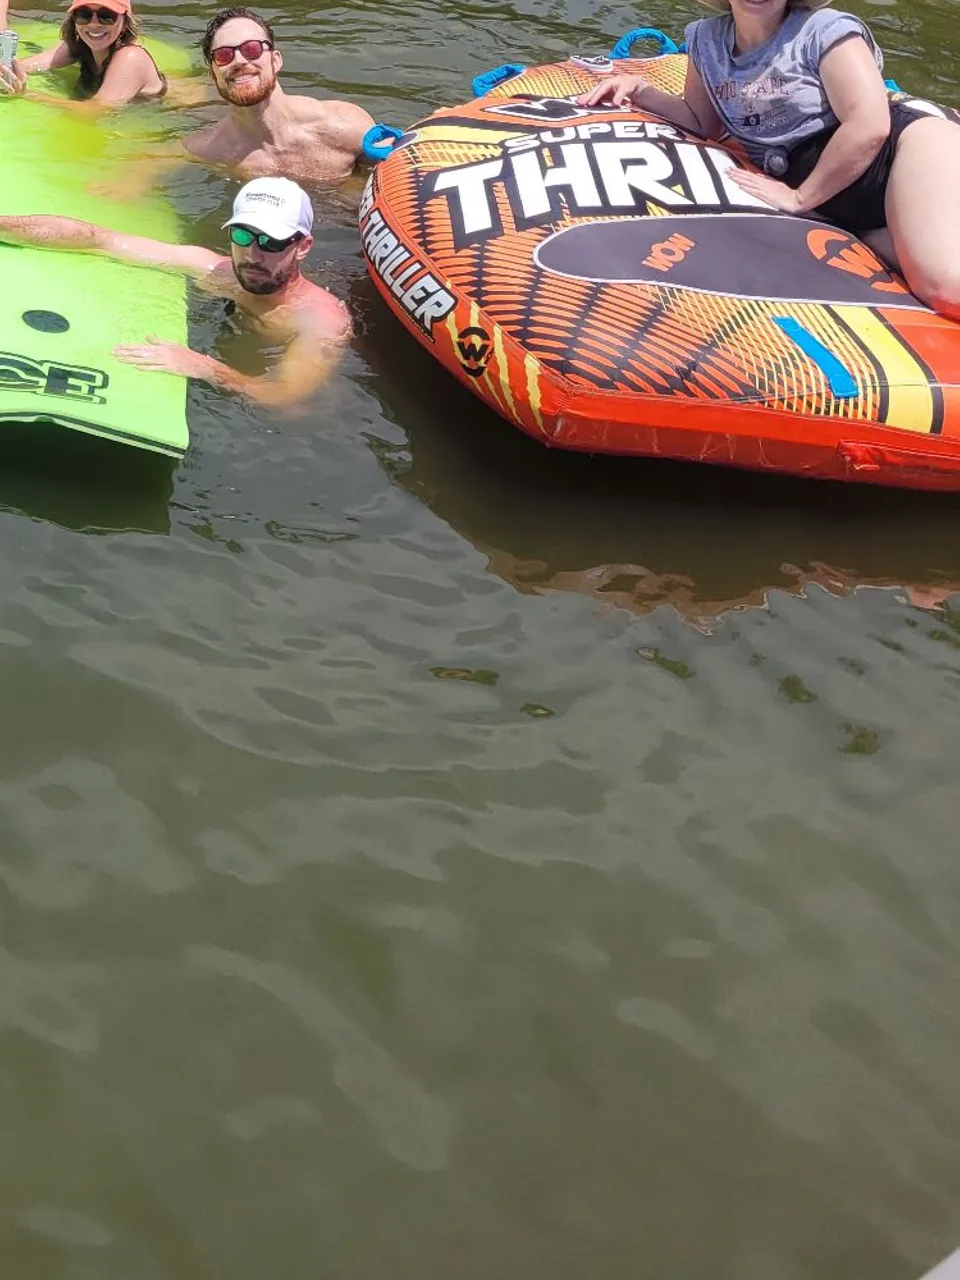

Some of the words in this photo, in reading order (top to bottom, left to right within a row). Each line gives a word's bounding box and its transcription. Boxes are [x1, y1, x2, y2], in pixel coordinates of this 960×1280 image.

[502, 121, 681, 153] SUPER
[363, 208, 456, 331] THRILLER
[642, 232, 696, 272] WOW
